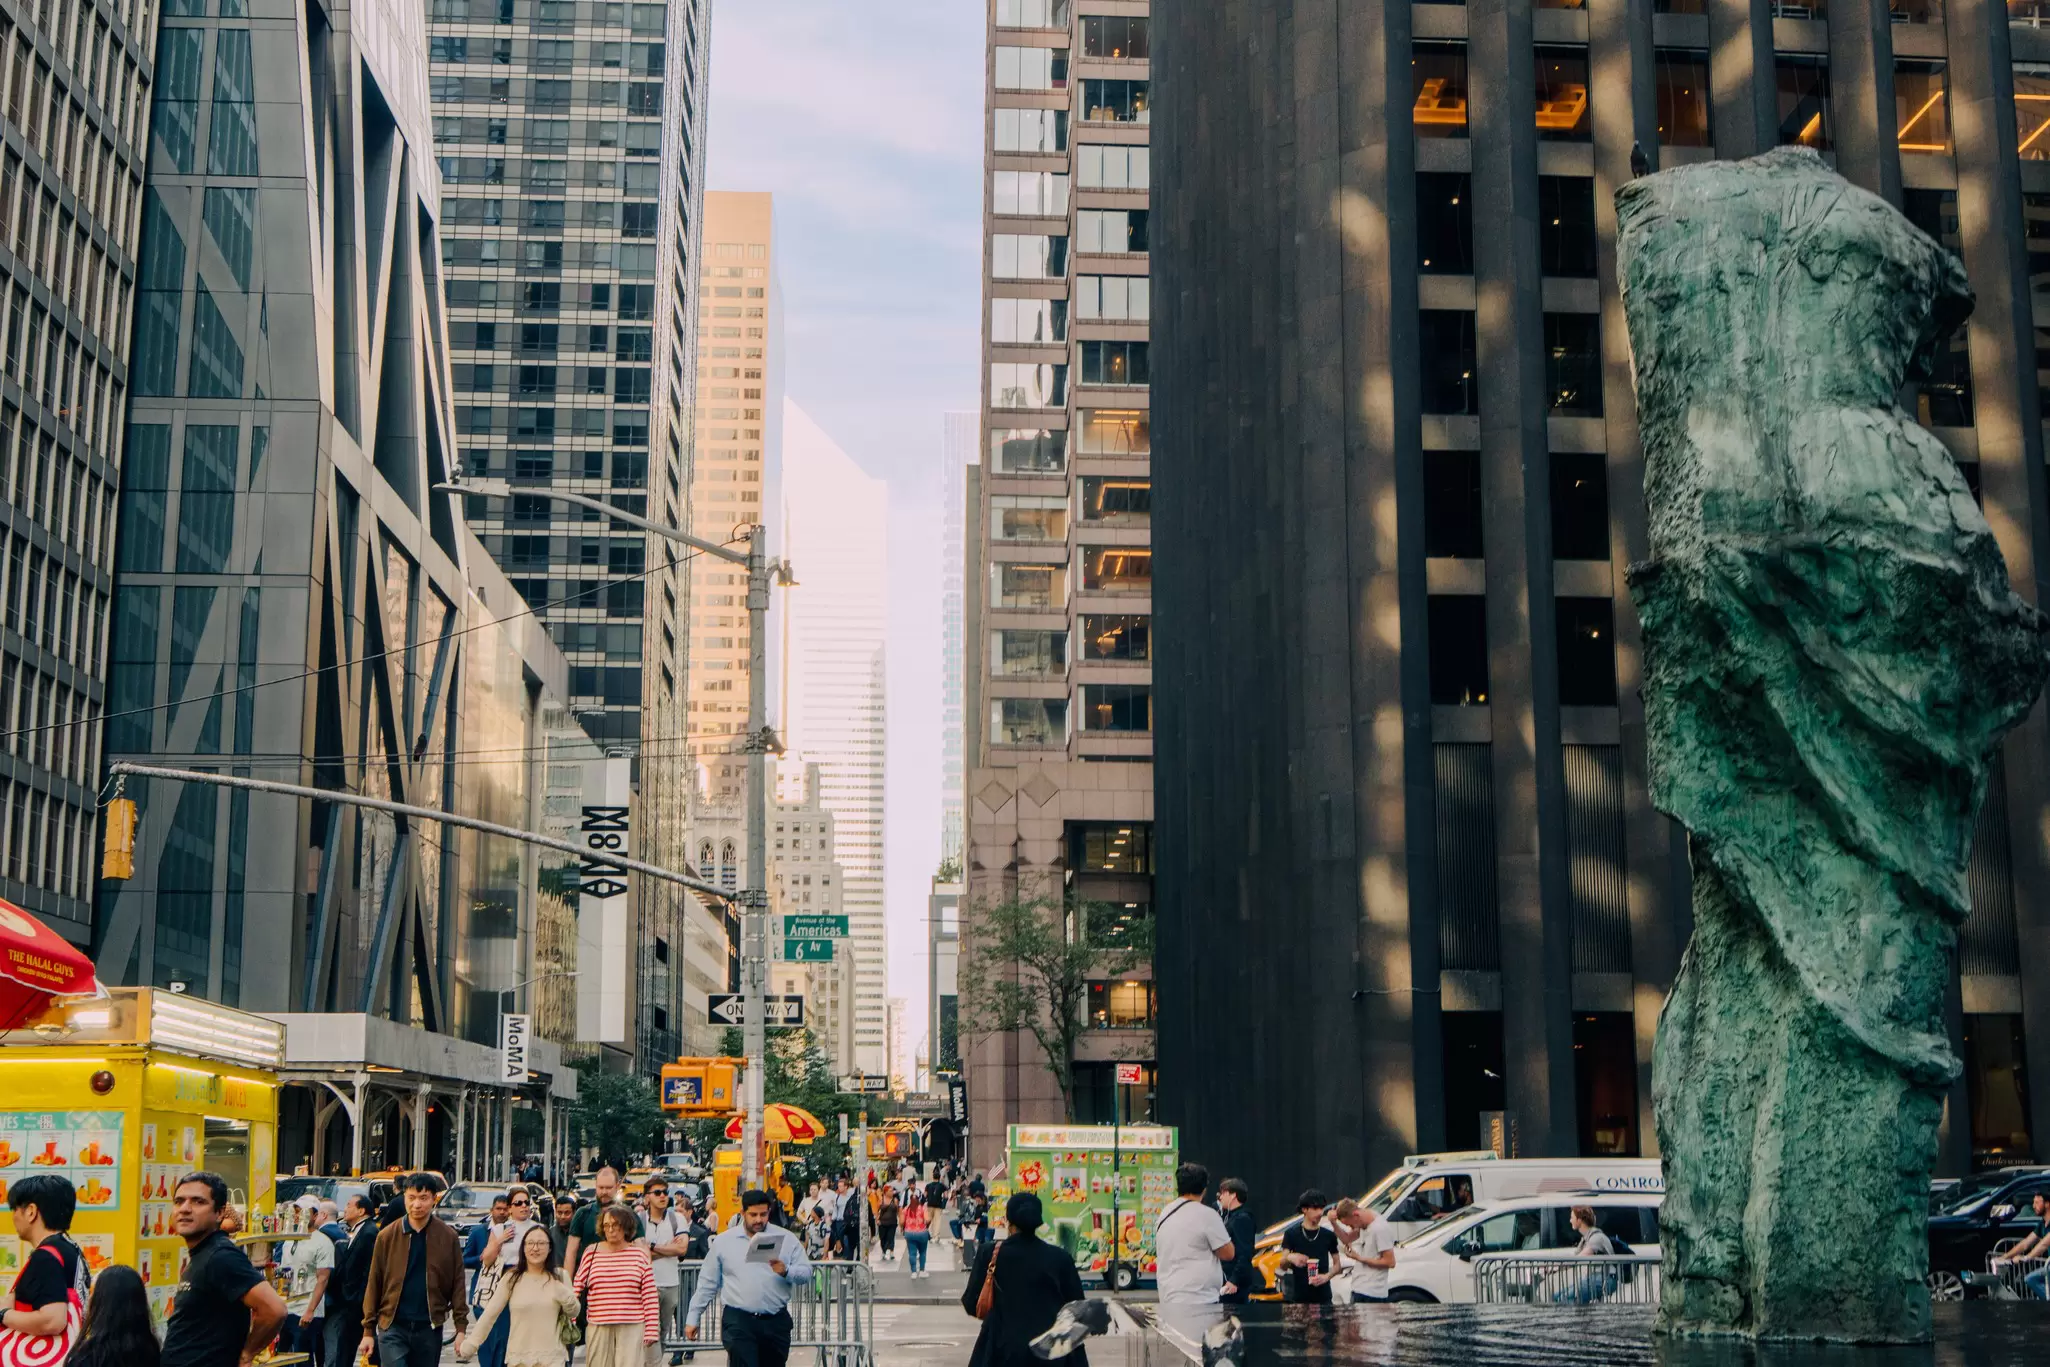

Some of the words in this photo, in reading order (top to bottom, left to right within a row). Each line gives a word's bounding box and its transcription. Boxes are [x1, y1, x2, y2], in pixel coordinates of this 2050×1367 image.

[790, 924, 842, 937] Americas
[8, 949, 26, 963] THE
[26, 954, 53, 971] HALAL
[795, 942, 804, 960] 6
[810, 940, 821, 952] Av
[726, 1003, 744, 1016] ON
[507, 1017, 525, 1078] MoMA
[952, 1086, 965, 1121] MoMA
[0, 1116, 19, 1129] IES
